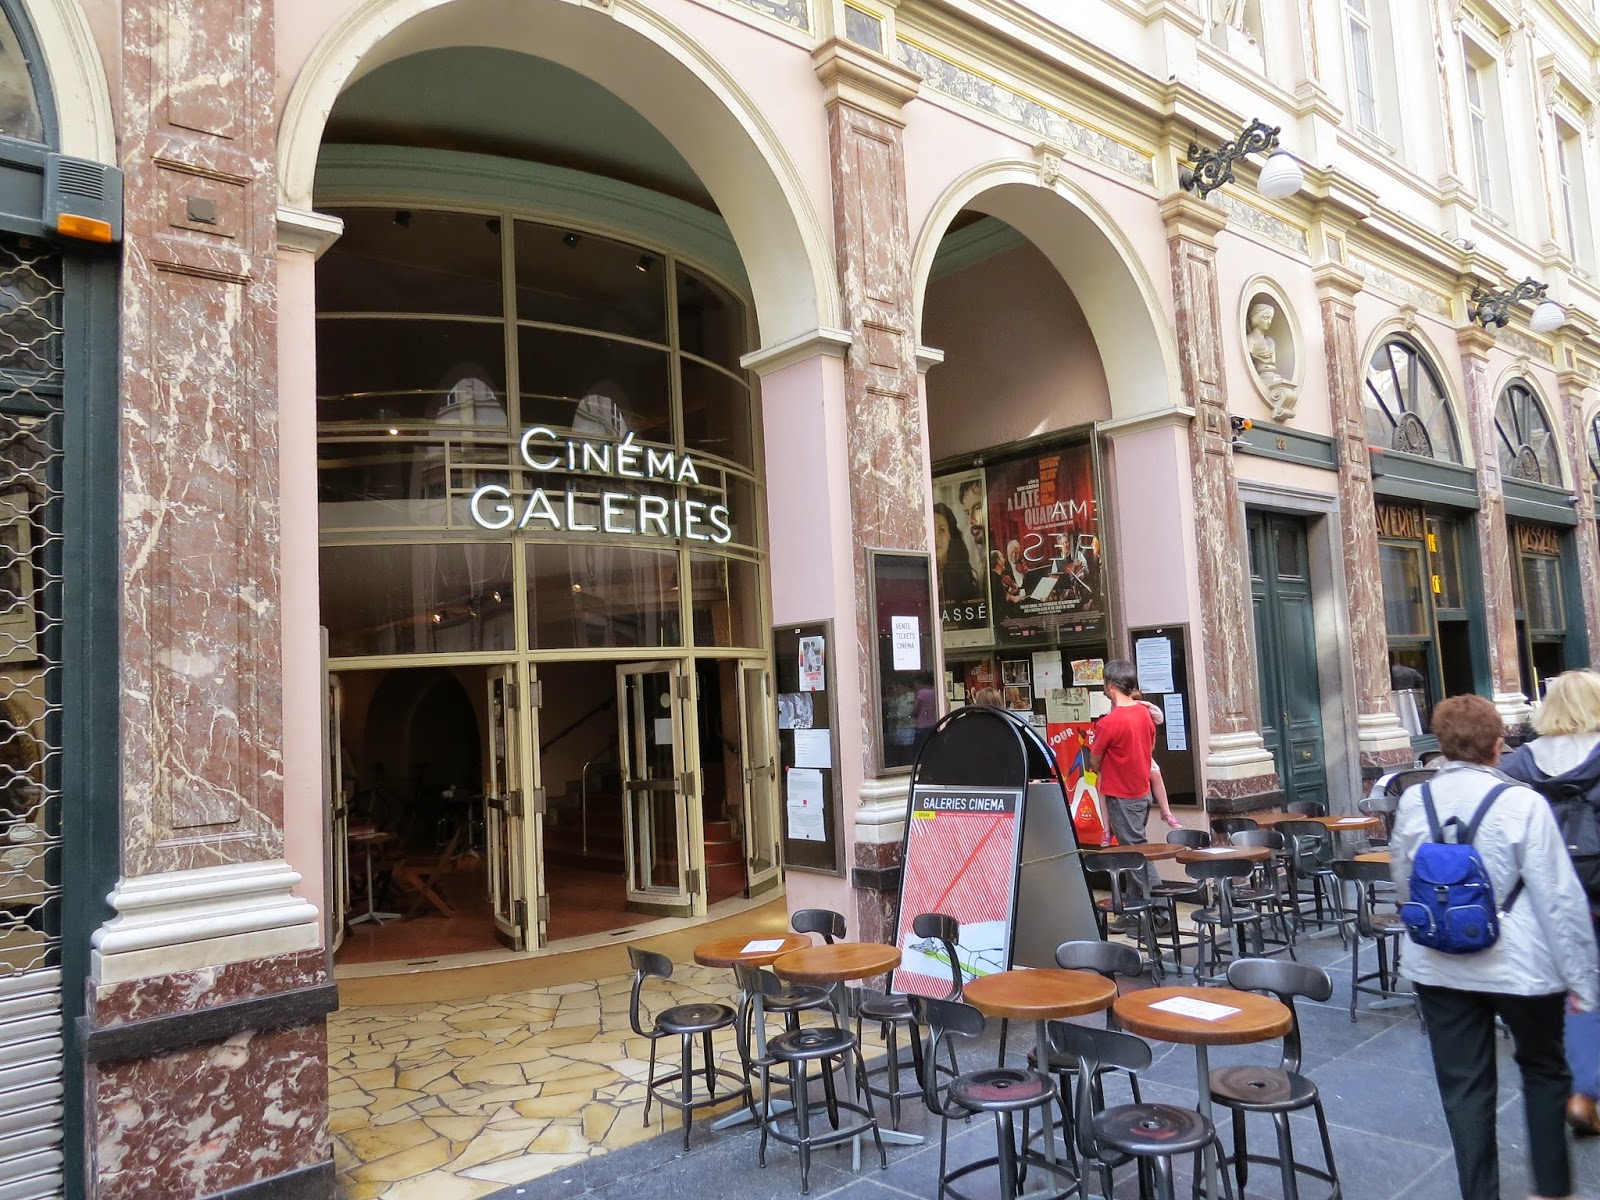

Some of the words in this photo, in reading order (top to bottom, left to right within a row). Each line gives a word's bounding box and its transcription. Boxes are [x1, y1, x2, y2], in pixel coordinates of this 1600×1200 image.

[520, 426, 700, 485] CINÉMA
[1007, 497, 1014, 512] A
[1013, 488, 1040, 511] LATE
[470, 484, 733, 544] GALERIES
[895, 622, 911, 630] VENTE
[896, 632, 916, 640] TICKETS
[1050, 727, 1075, 747] JOUR
[923, 797, 967, 810] GALERIES
[968, 798, 1005, 811] CINEMA
